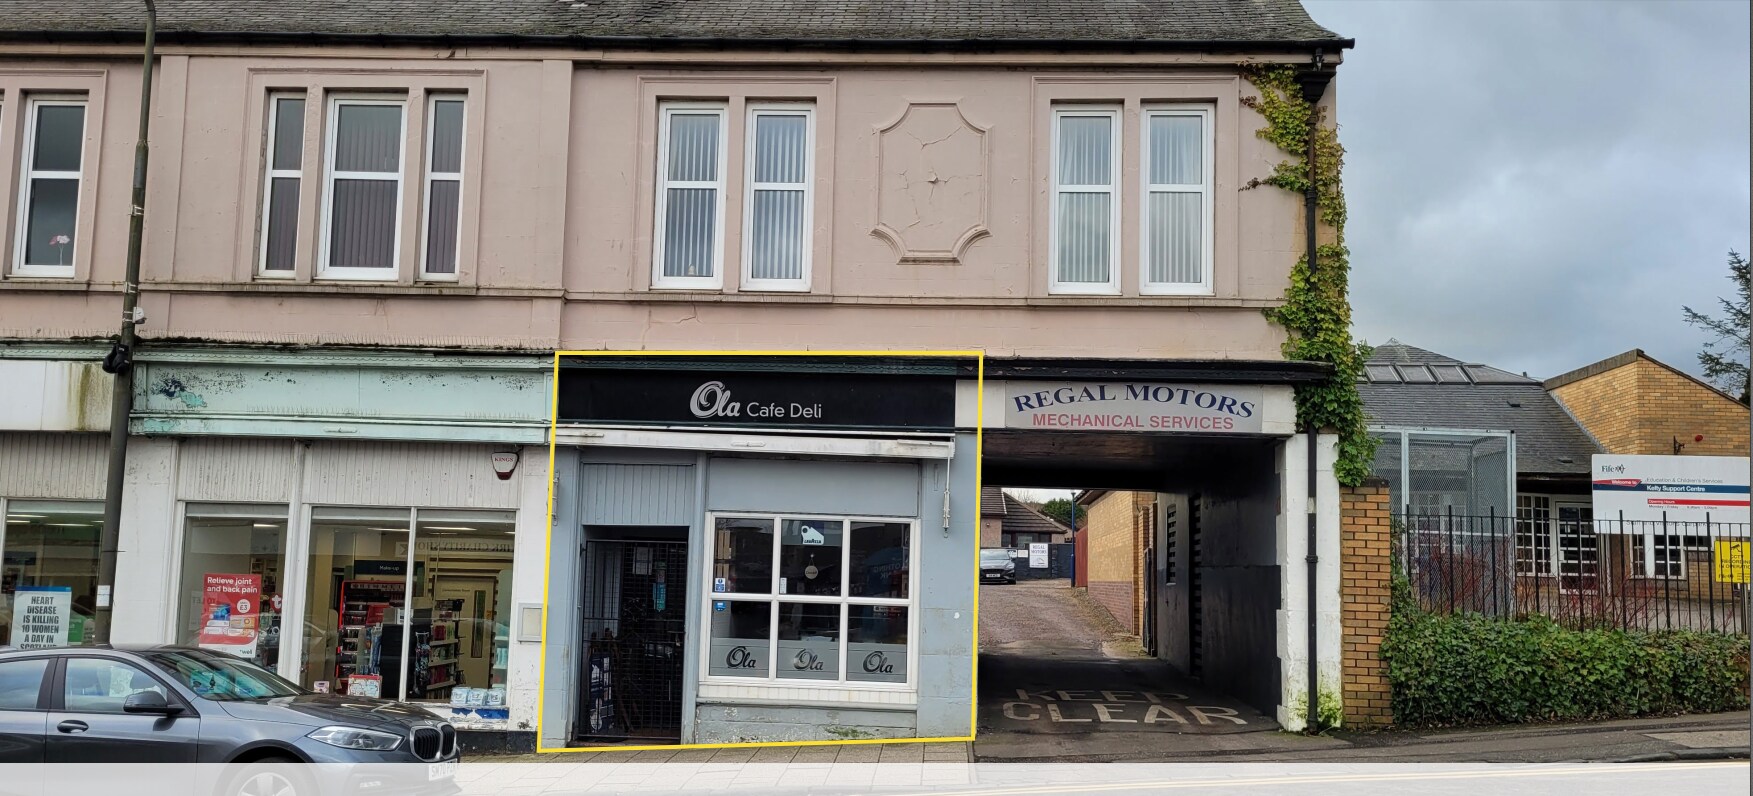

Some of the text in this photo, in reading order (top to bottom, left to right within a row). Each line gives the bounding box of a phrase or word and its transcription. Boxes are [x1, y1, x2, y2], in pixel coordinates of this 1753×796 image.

[689, 380, 822, 419] Ola Cafe Deli
[1013, 384, 1256, 418] REGAL MOTORS
[1032, 413, 1234, 430] MECHANICAL SERVICES
[207, 576, 252, 586] Relieve joint
[222, 585, 241, 593] back
[241, 586, 258, 594] pain
[31, 596, 54, 605] HEART
[27, 606, 57, 615] DISEASE
[23, 615, 59, 624] IS KILLING
[22, 625, 59, 633] 10 WOMEN
[24, 634, 54, 643] A DAY IN
[726, 646, 757, 669] Ola
[863, 650, 893, 673] Ola
[1015, 689, 1190, 704] KEEP
[1003, 702, 1248, 725] CLEAR
